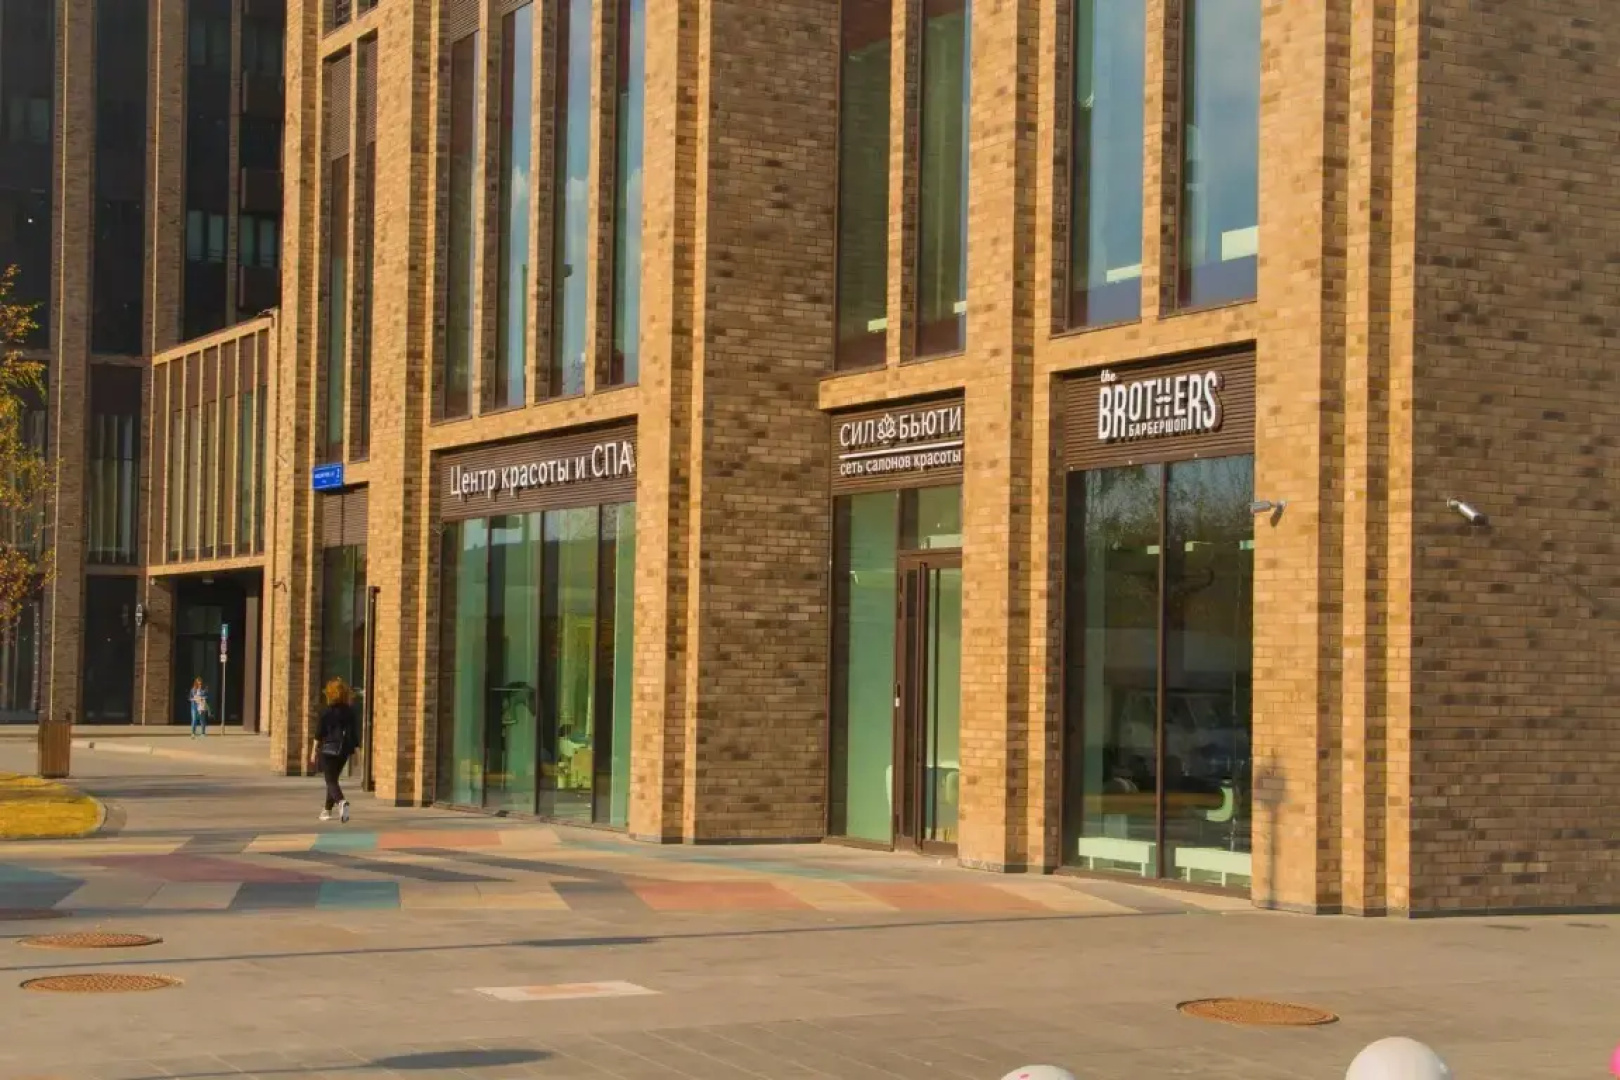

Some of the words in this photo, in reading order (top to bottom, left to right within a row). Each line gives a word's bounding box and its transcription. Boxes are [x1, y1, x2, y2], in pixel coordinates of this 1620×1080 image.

[1100, 369, 1117, 382] the
[1098, 370, 1218, 440] BROTHERS
[899, 406, 962, 440] БЬЮТИ
[1128, 418, 1188, 437] БАРБЕРШОП
[450, 464, 496, 501] Центр
[501, 457, 569, 496] красоты
[575, 456, 586, 479] и
[591, 440, 634, 478] СПА
[840, 461, 863, 476] сеть
[865, 456, 911, 473] салонов
[913, 449, 962, 472] красоты
